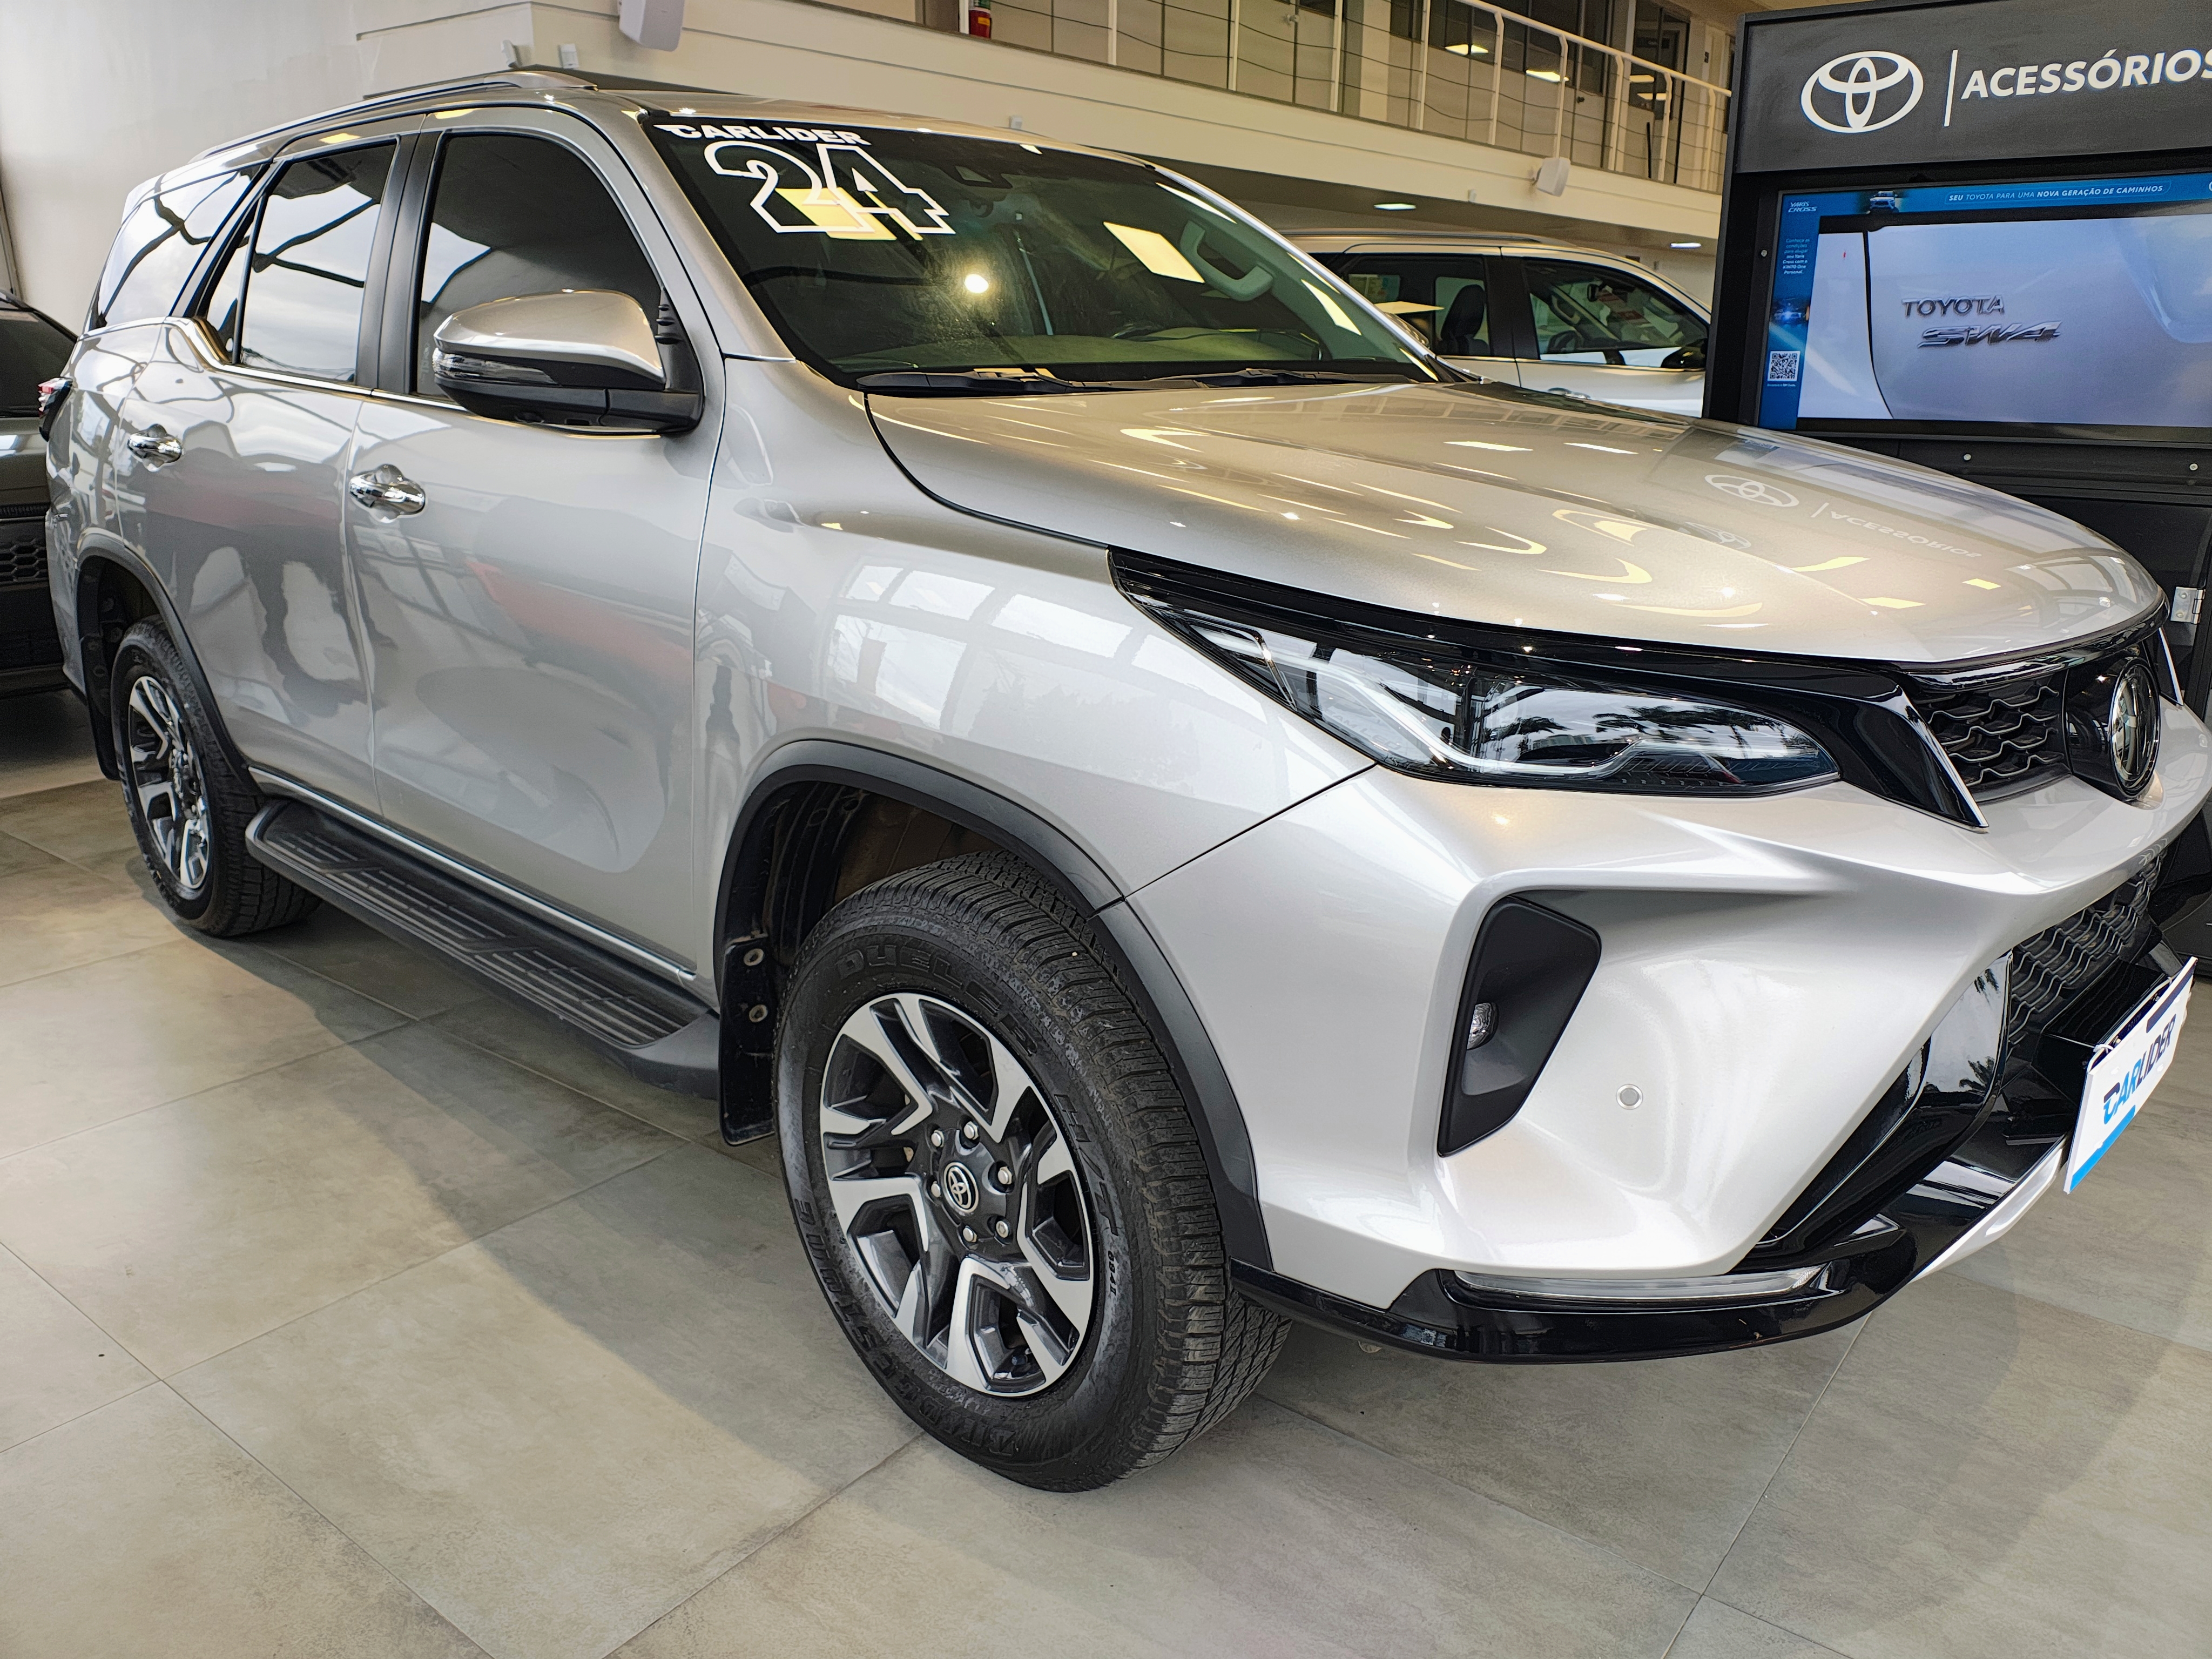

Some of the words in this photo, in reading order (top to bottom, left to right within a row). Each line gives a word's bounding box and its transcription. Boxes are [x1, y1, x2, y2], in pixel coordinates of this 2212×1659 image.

[653, 124, 872, 145] CARLIDER
[704, 140, 956, 234] 24
[2062, 187, 2101, 197] GERAÇÃO
[2116, 185, 2163, 194] CAMINHOS
[1901, 295, 2005, 318] TOYOTA
[1917, 321, 2062, 348] SW4
[834, 944, 1037, 1056] DUELER
[2103, 1013, 2177, 1125] CARLIDER
